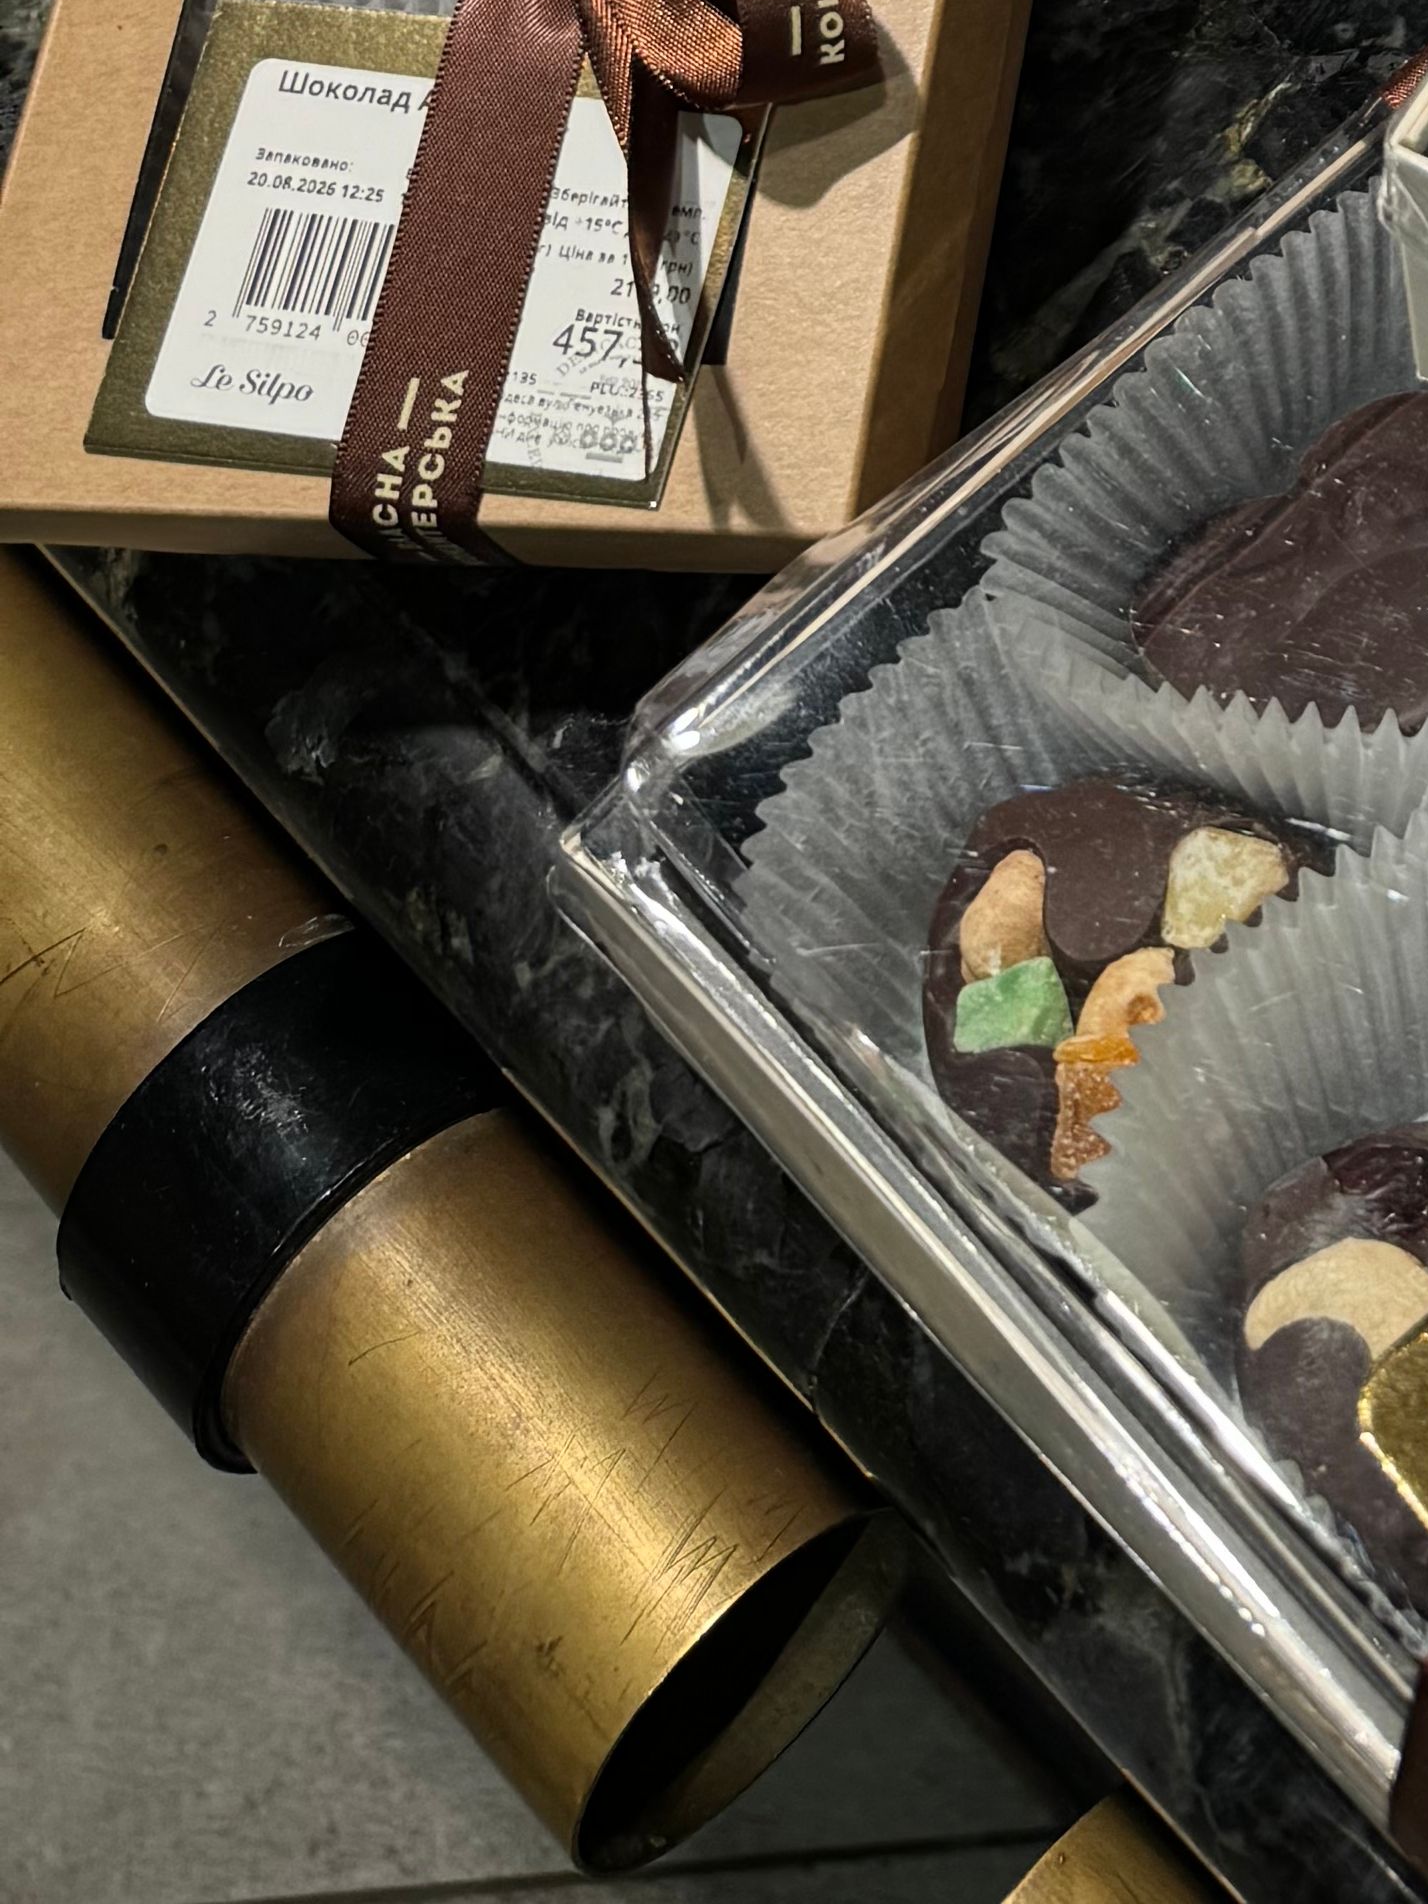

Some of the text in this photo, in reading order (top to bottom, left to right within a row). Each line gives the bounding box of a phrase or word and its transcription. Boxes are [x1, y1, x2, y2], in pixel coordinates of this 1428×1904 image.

[278, 69, 412, 114] Шоколад
[255, 147, 354, 173] Запаковано:
[341, 184, 385, 203] 12:25
[558, 245, 593, 262] Ціна
[204, 310, 322, 341] 2 759124
[190, 363, 315, 406] Le Silpo
